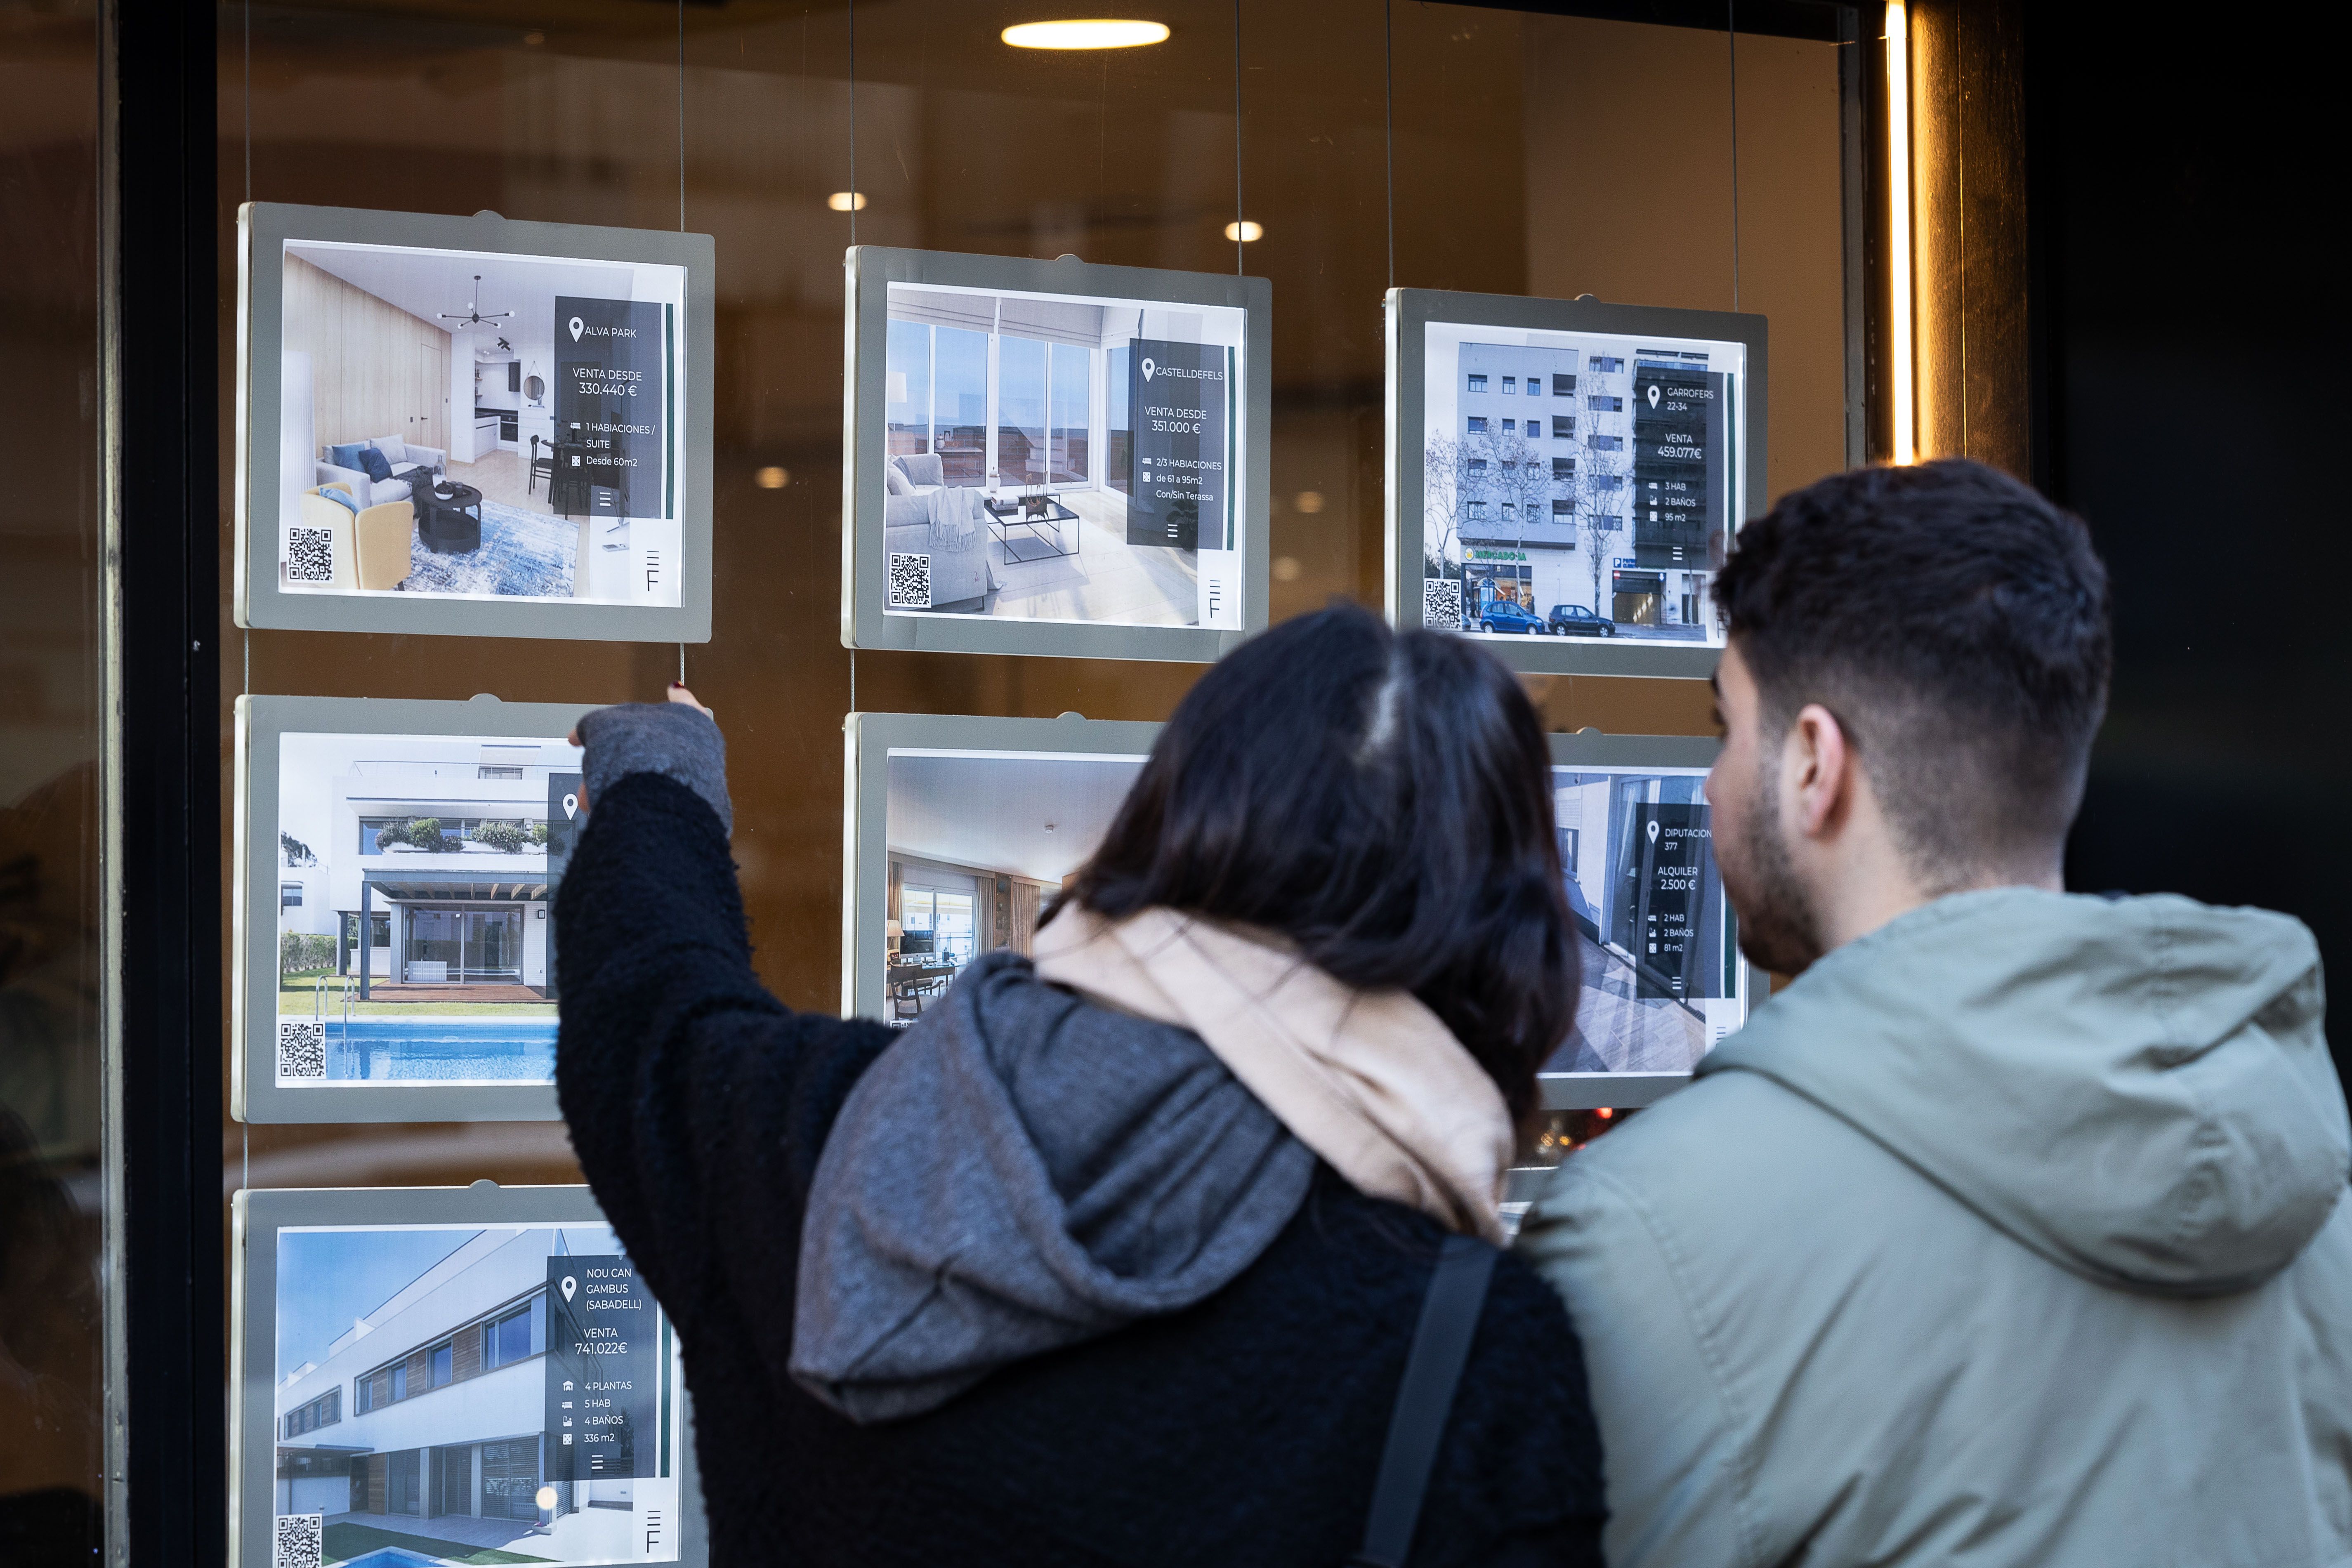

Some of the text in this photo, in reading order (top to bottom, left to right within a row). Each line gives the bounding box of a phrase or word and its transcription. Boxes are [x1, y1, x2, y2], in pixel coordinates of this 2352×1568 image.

[585, 326, 637, 338] ALVA PARK
[573, 368, 642, 381] VENTA DESDE
[1156, 367, 1223, 380] CASTELLDEFELS
[579, 382, 637, 396] 330.440 €
[1667, 388, 1714, 399] GARROFERS
[1667, 402, 1687, 411] 22-34
[1144, 406, 1207, 419] VENTA DESDE
[586, 422, 589, 431] 1
[592, 423, 650, 434] HABIACIONES
[1152, 420, 1201, 434] 351.000 €
[1666, 434, 1692, 443] VENTA
[586, 439, 610, 449] SUITE
[1658, 446, 1701, 459] 459.077€
[587, 456, 637, 467] Desde 60m2
[1156, 457, 1222, 470] 2/3 HABIACIONES
[1182, 476, 1202, 484] 95m2
[1156, 490, 1213, 501] Con/Sin Terassa
[1671, 497, 1695, 507] BAÑOS
[1665, 829, 1712, 837] DIPUTACION
[1658, 867, 1698, 877] ALQUILER
[1661, 879, 1695, 890] 2.500 €
[1670, 928, 1694, 937] BAÑOS
[587, 1268, 631, 1278] NOU CAN
[586, 1284, 628, 1294] GAMBUS
[586, 1299, 642, 1311] (SABADELL)
[584, 1328, 618, 1338] VENTA
[575, 1342, 628, 1355] 741.022€
[593, 1381, 632, 1390] PLANTAS
[585, 1399, 610, 1408] 5 HAB
[593, 1415, 623, 1425] BAÑOS
[584, 1434, 599, 1442] 336
